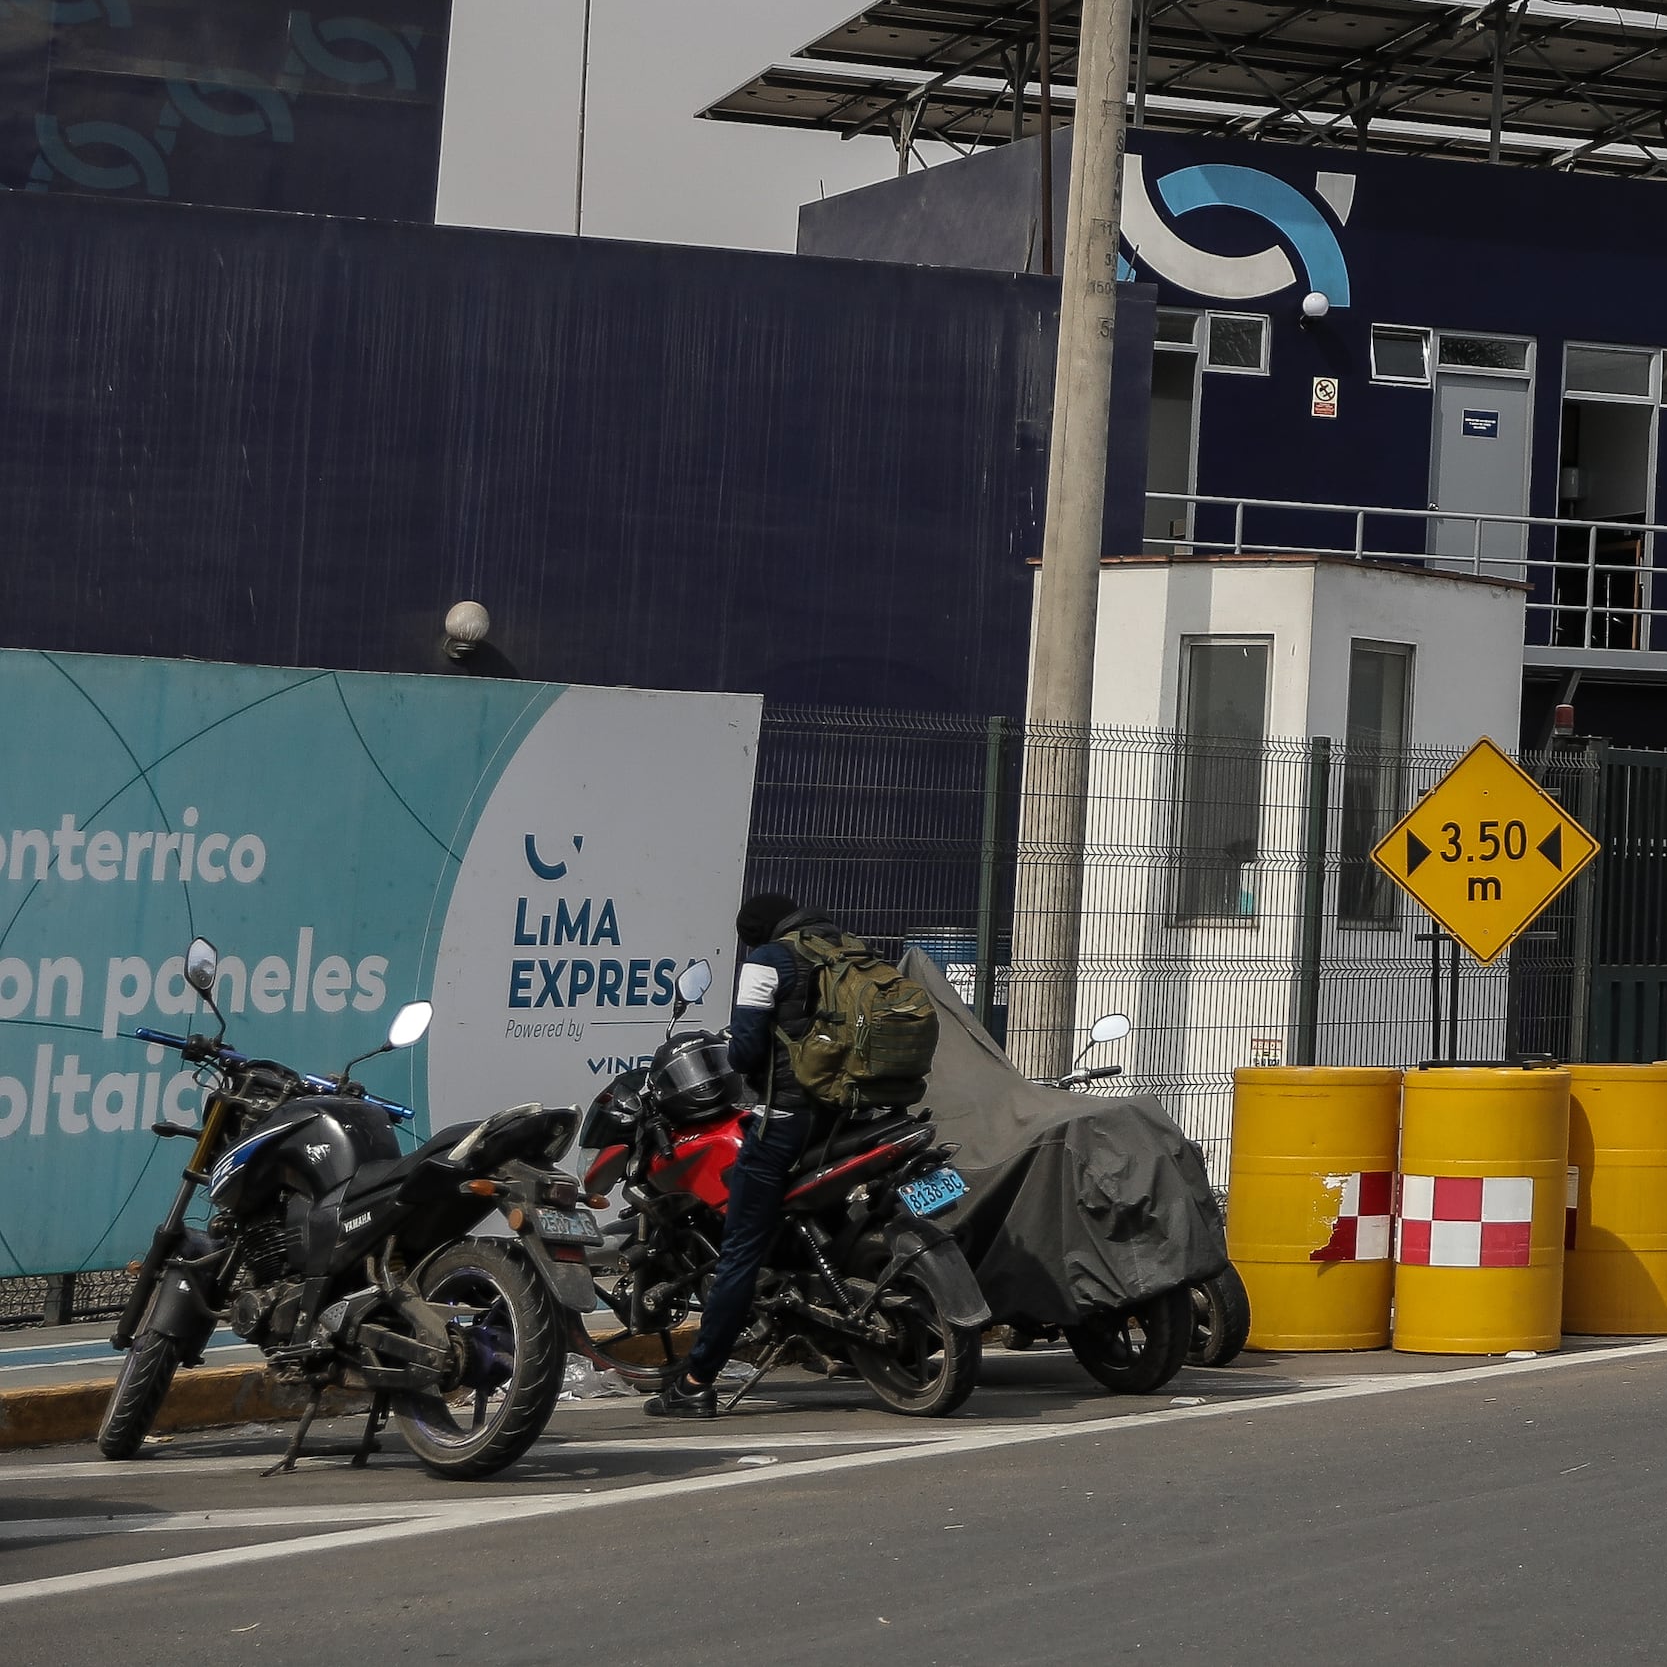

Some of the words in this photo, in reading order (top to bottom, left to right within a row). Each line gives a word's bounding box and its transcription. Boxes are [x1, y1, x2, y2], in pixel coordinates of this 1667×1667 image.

[1440, 819, 1527, 863] 3.50
[1467, 876, 1502, 901] m
[102, 927, 390, 1039] paneles
[508, 958, 704, 1008] EXPRES
[505, 1019, 563, 1038] Powered
[567, 1019, 584, 1041] by
[0, 1043, 213, 1135] oltaic
[909, 1174, 962, 1210] 8138-BC
[344, 1211, 372, 1233] YAMAHA
